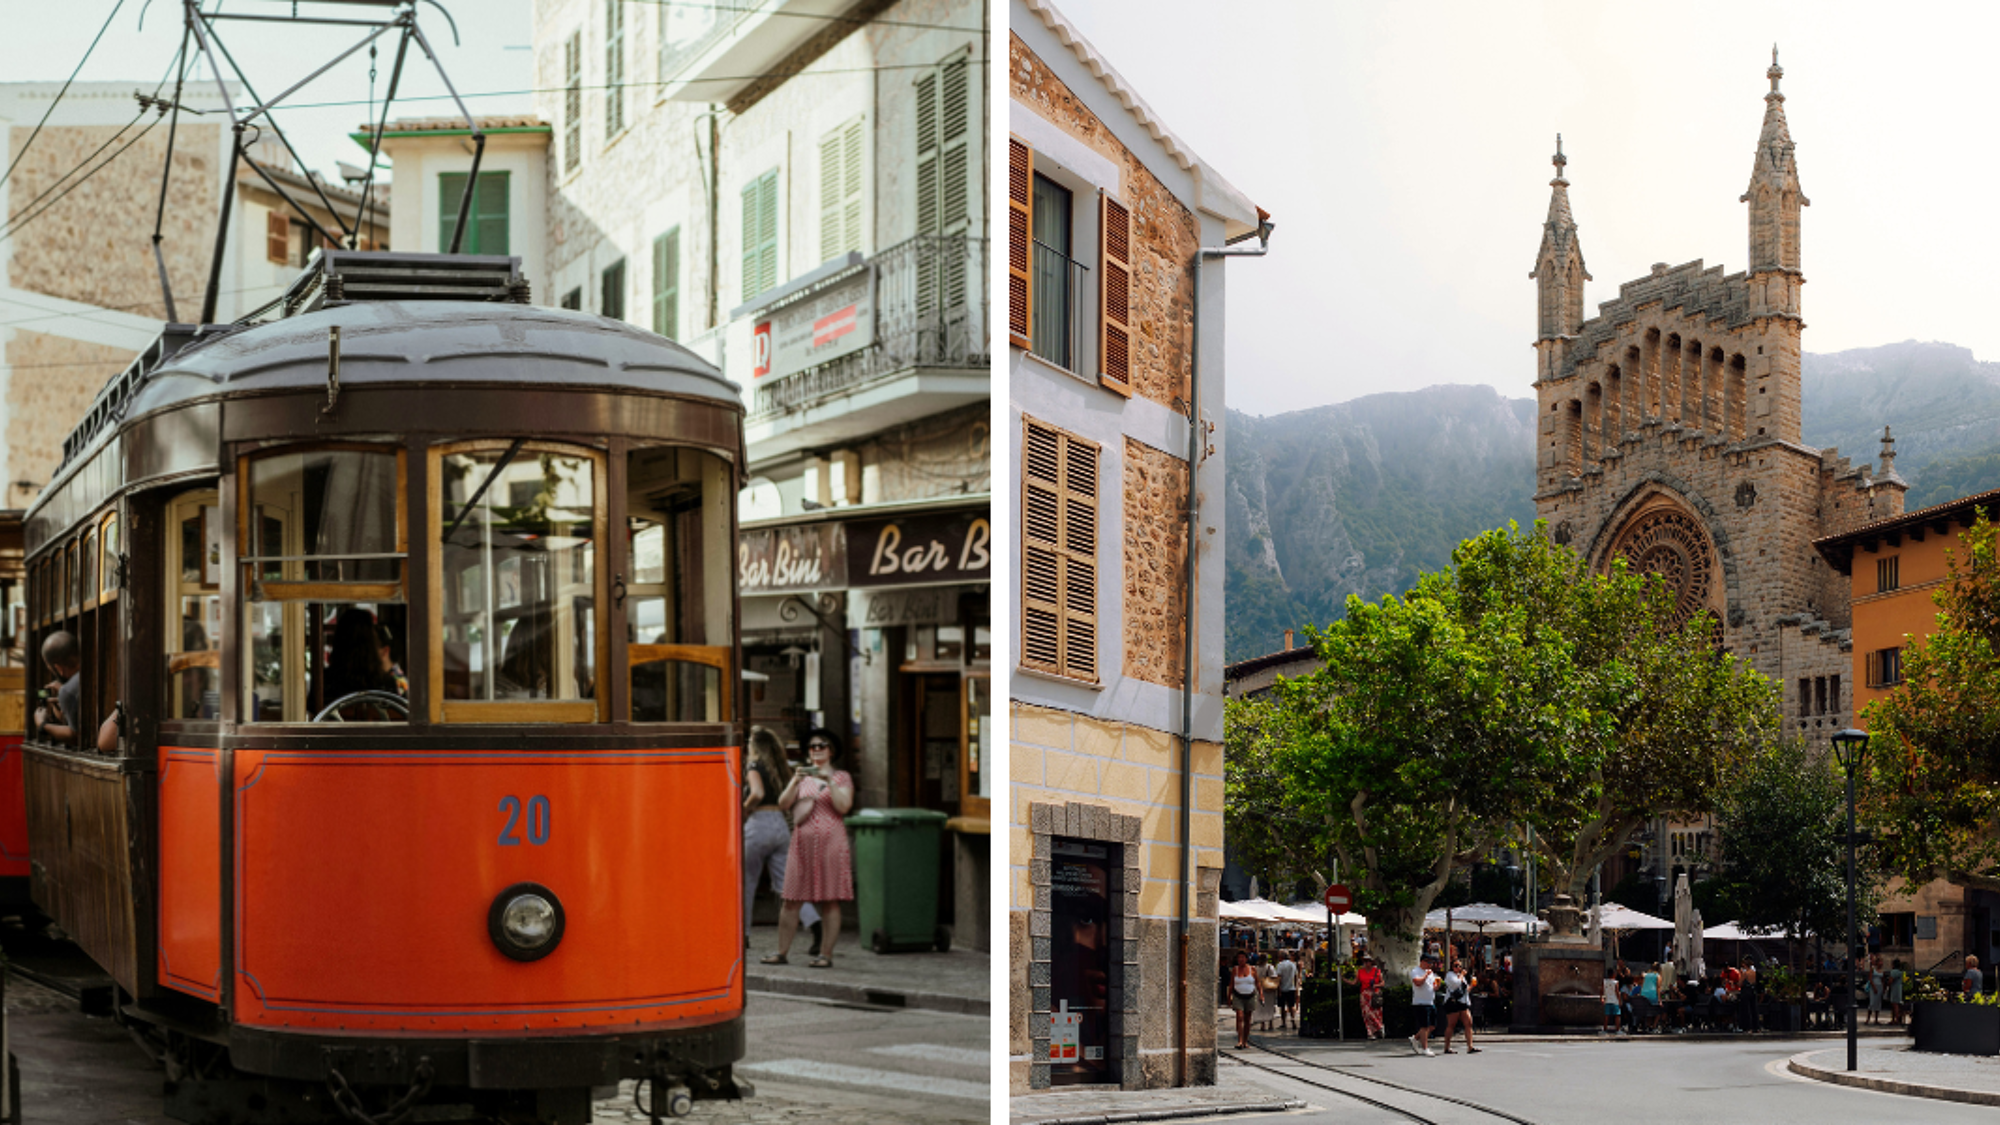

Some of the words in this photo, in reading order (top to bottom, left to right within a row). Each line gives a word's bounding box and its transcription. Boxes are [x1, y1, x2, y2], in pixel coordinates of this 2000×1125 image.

[739, 542, 770, 587] Bar
[773, 539, 822, 586] Bini
[868, 523, 950, 576] Bar
[497, 794, 551, 846] 20
